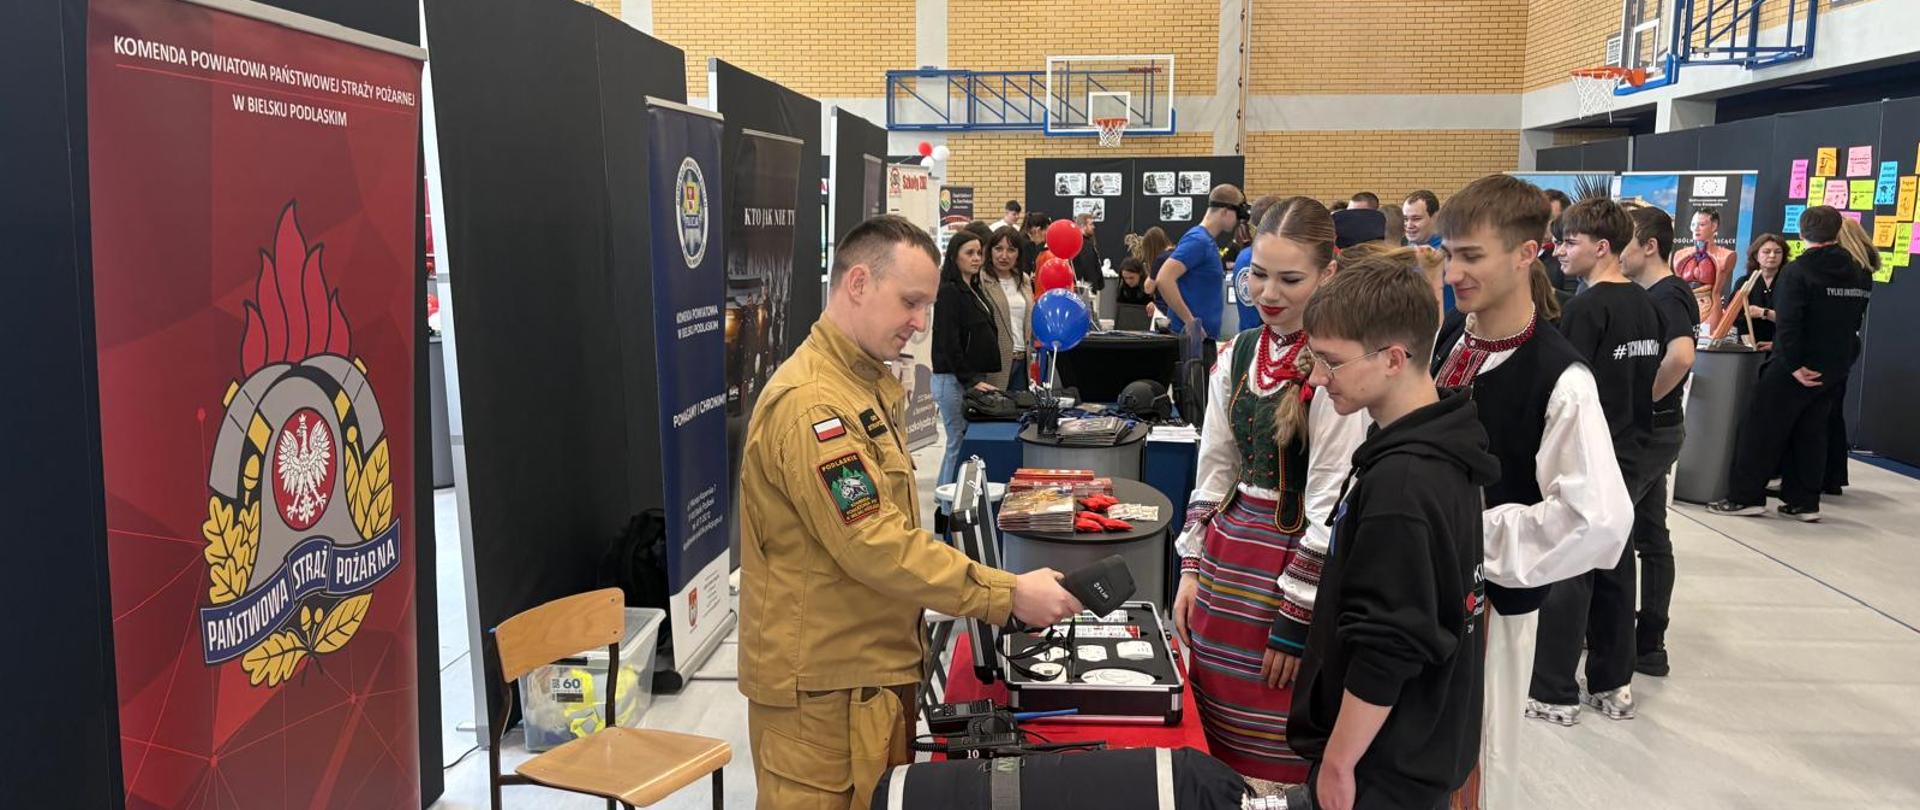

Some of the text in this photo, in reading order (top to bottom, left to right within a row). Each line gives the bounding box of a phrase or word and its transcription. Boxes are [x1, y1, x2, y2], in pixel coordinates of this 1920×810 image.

[114, 35, 415, 106] KOMENDA POWIATOWA PAŃSTWOWEJ STRAŻY POŻARNEJ
[233, 94, 347, 127] W BIELSKU PODLASKIM
[745, 208, 761, 226] KTO
[292, 545, 327, 590] STRAŻ
[336, 539, 395, 585] POŻARNA
[207, 577, 289, 651] PAŃSTWOWA
[563, 678, 581, 689] 60
[967, 749, 980, 759] 10
